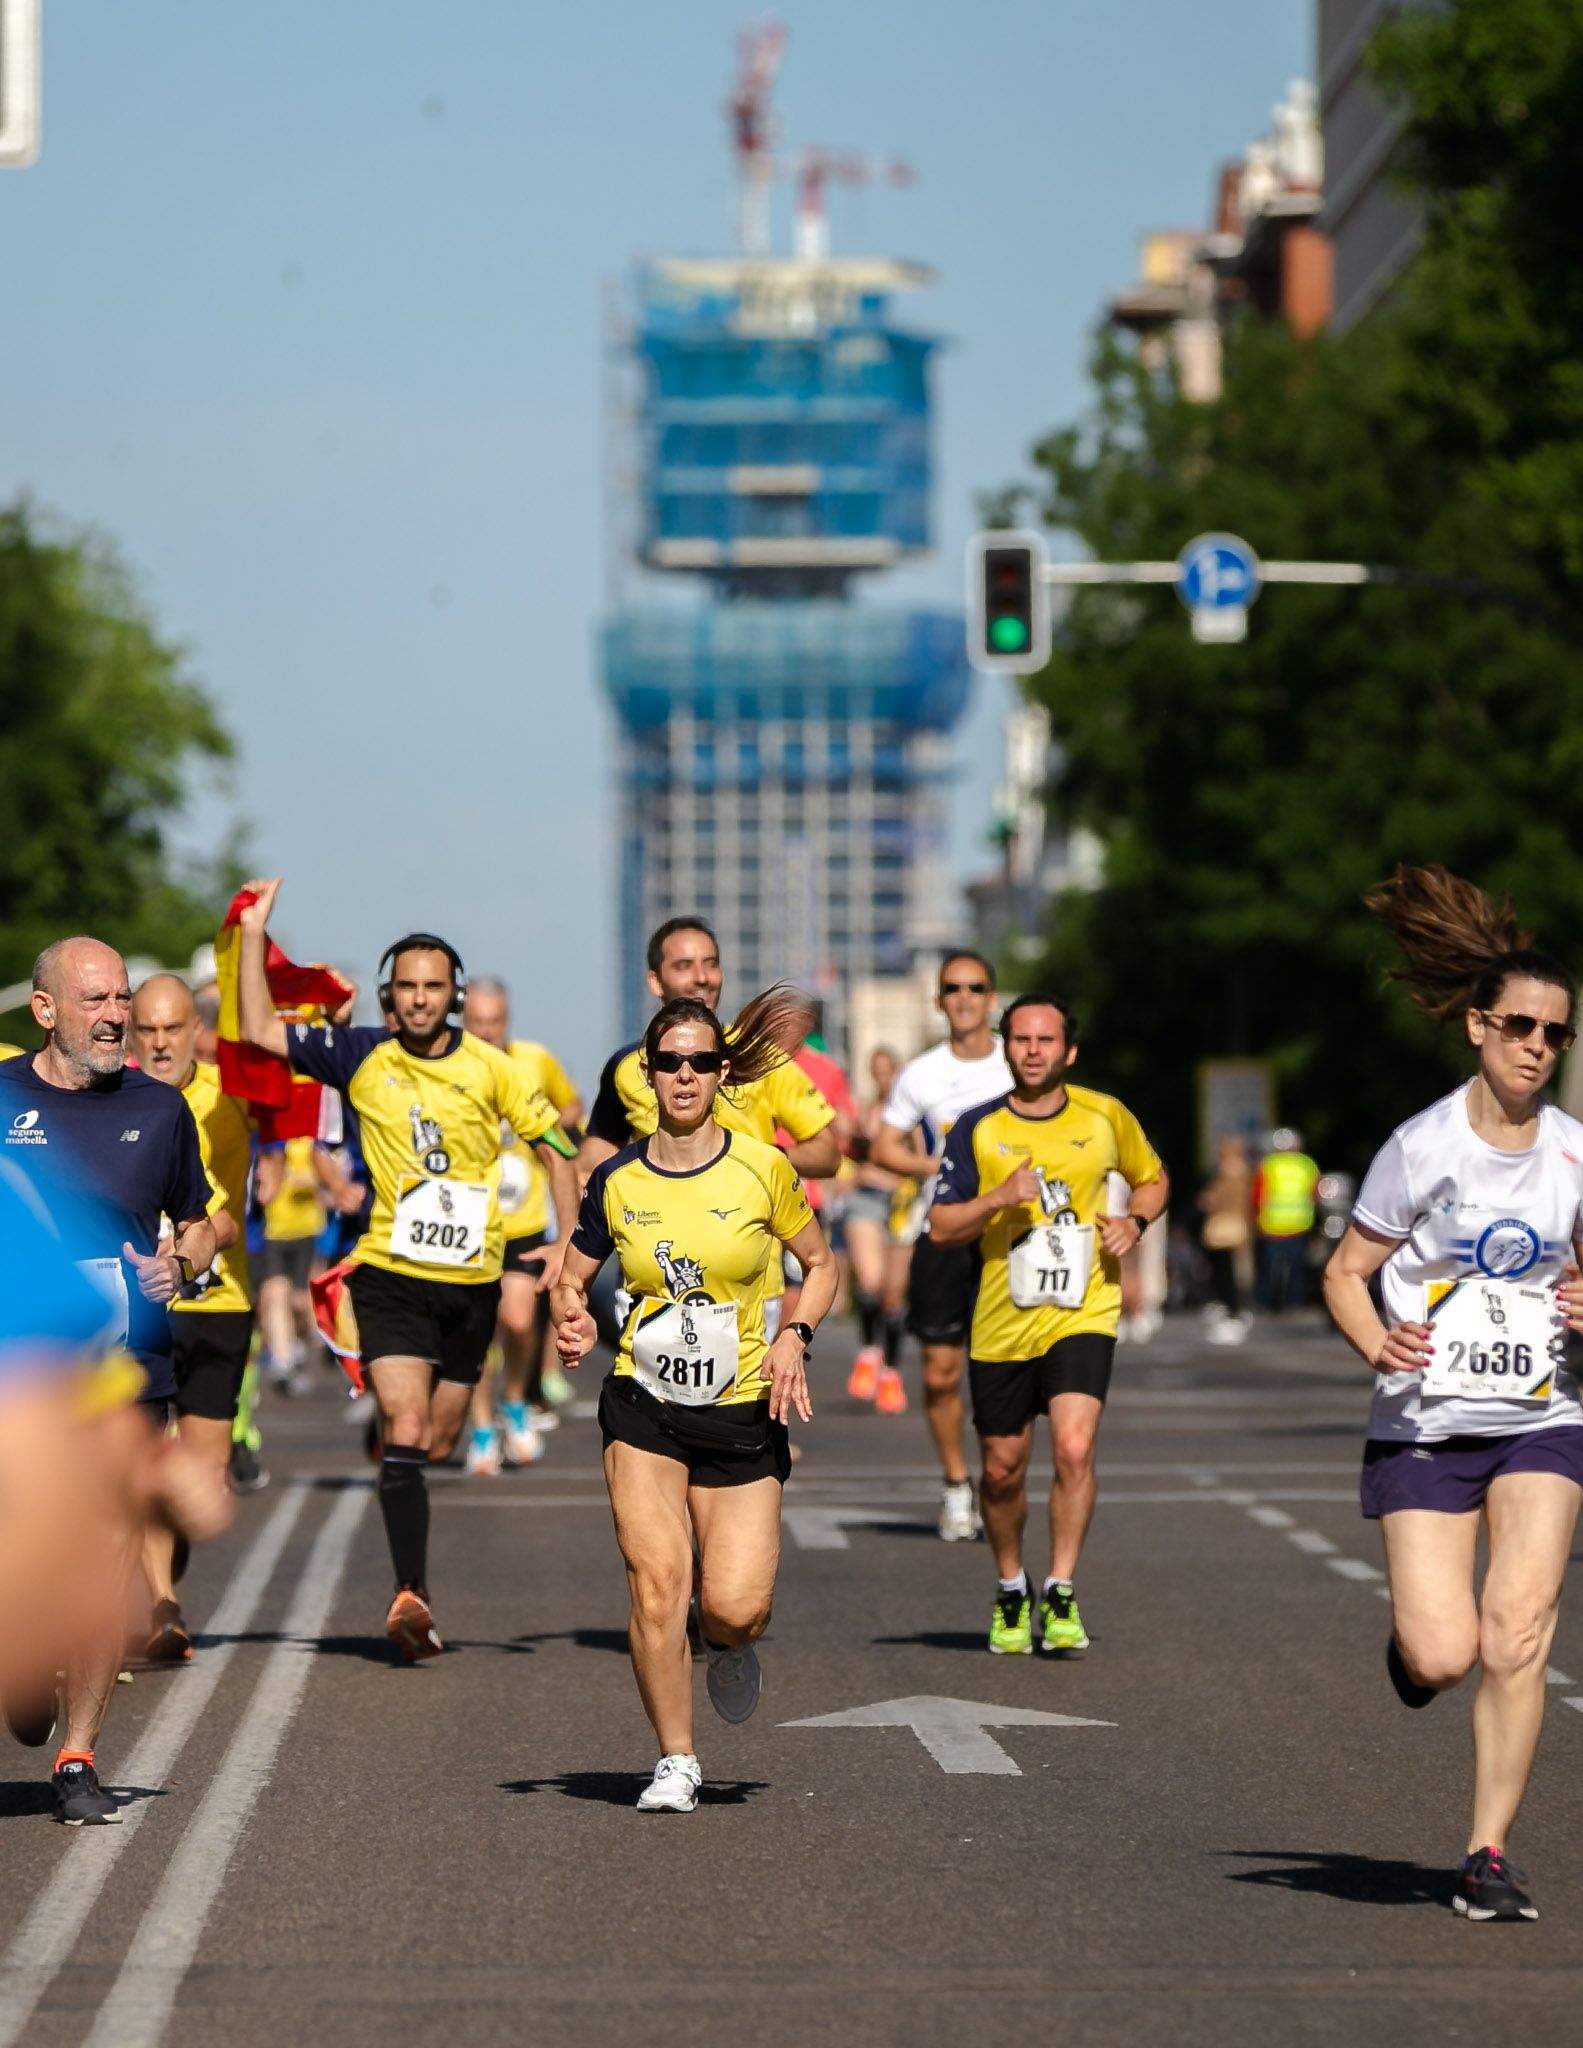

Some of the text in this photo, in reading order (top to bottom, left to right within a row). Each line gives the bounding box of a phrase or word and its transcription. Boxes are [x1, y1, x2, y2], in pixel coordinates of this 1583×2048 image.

[5, 1136, 48, 1144] marbella
[8, 1129, 45, 1137] seguros
[429, 1153, 448, 1171] 13
[410, 1220, 469, 1250] 3202
[1036, 1268, 1071, 1291] 717
[1447, 1340, 1534, 1377] 2636
[655, 1353, 715, 1388] 2811
